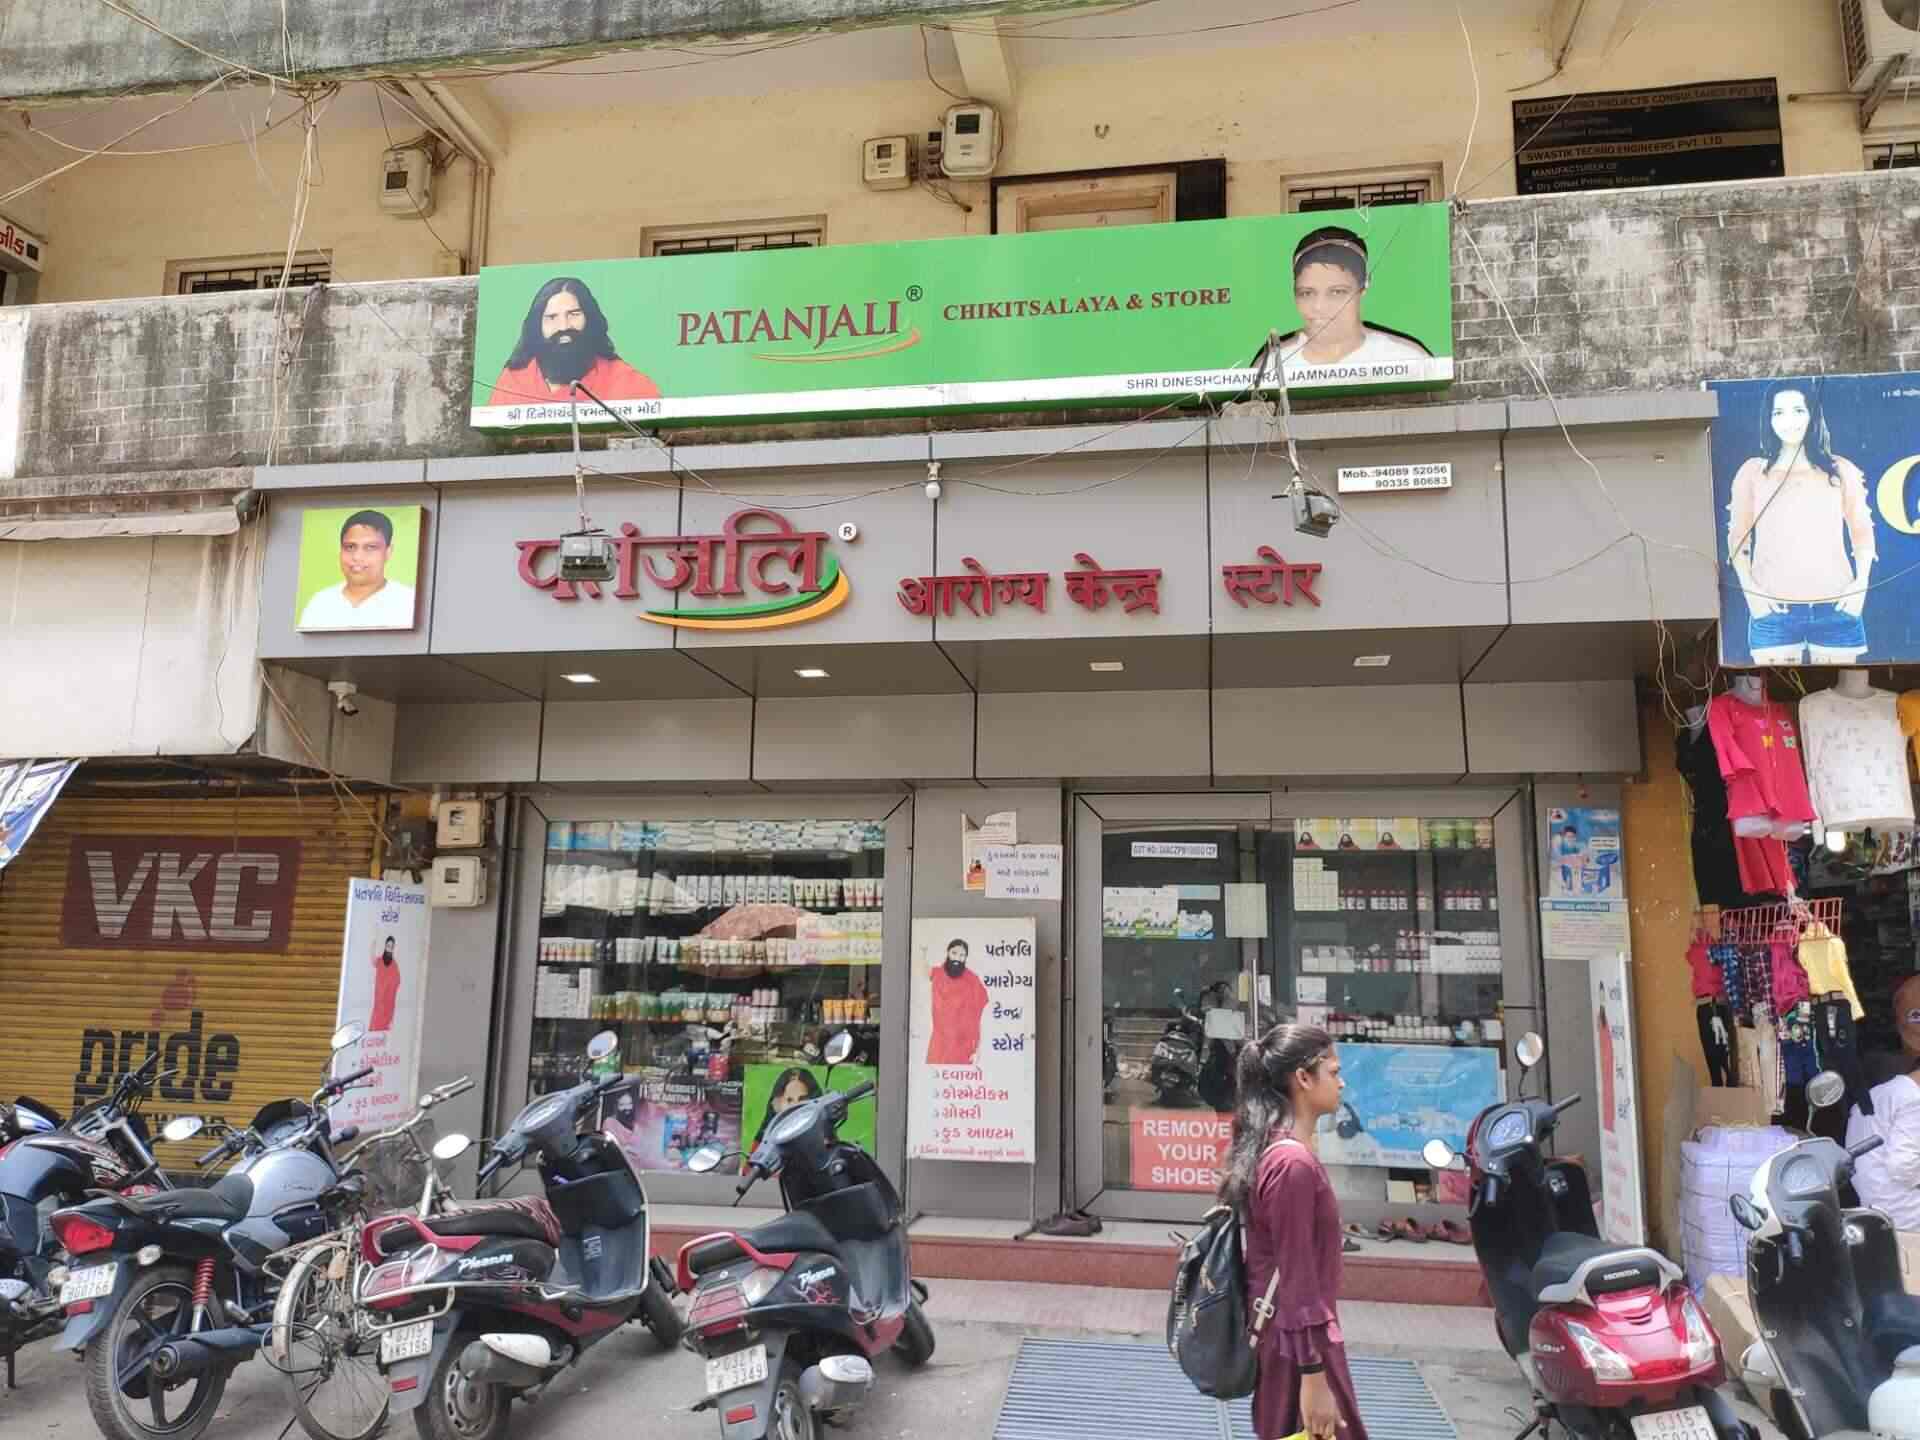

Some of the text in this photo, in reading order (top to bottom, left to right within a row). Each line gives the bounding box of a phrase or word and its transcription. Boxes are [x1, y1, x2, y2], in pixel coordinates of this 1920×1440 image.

[943, 287, 1231, 321] CHIKITSALAYA & STORE
[677, 300, 902, 350] PATANJALI
[1127, 378, 1158, 390] SHRI
[1288, 365, 1368, 382] JAMNADAS
[1371, 363, 1409, 377] MODI
[896, 545, 1323, 617] आरोग्य केन्द्र स्टोर
[84, 849, 281, 942] VKC
[985, 938, 1032, 957] પતંજલિ
[983, 969, 1033, 988] આરોગ્ય
[993, 1001, 1022, 1020] કેન્દ્ર
[992, 1032, 1025, 1051] સ્ટોર્સ
[73, 1008, 240, 1117] pride
[1143, 1119, 1232, 1138] REMOVE
[1158, 1143, 1218, 1162] YOUR
